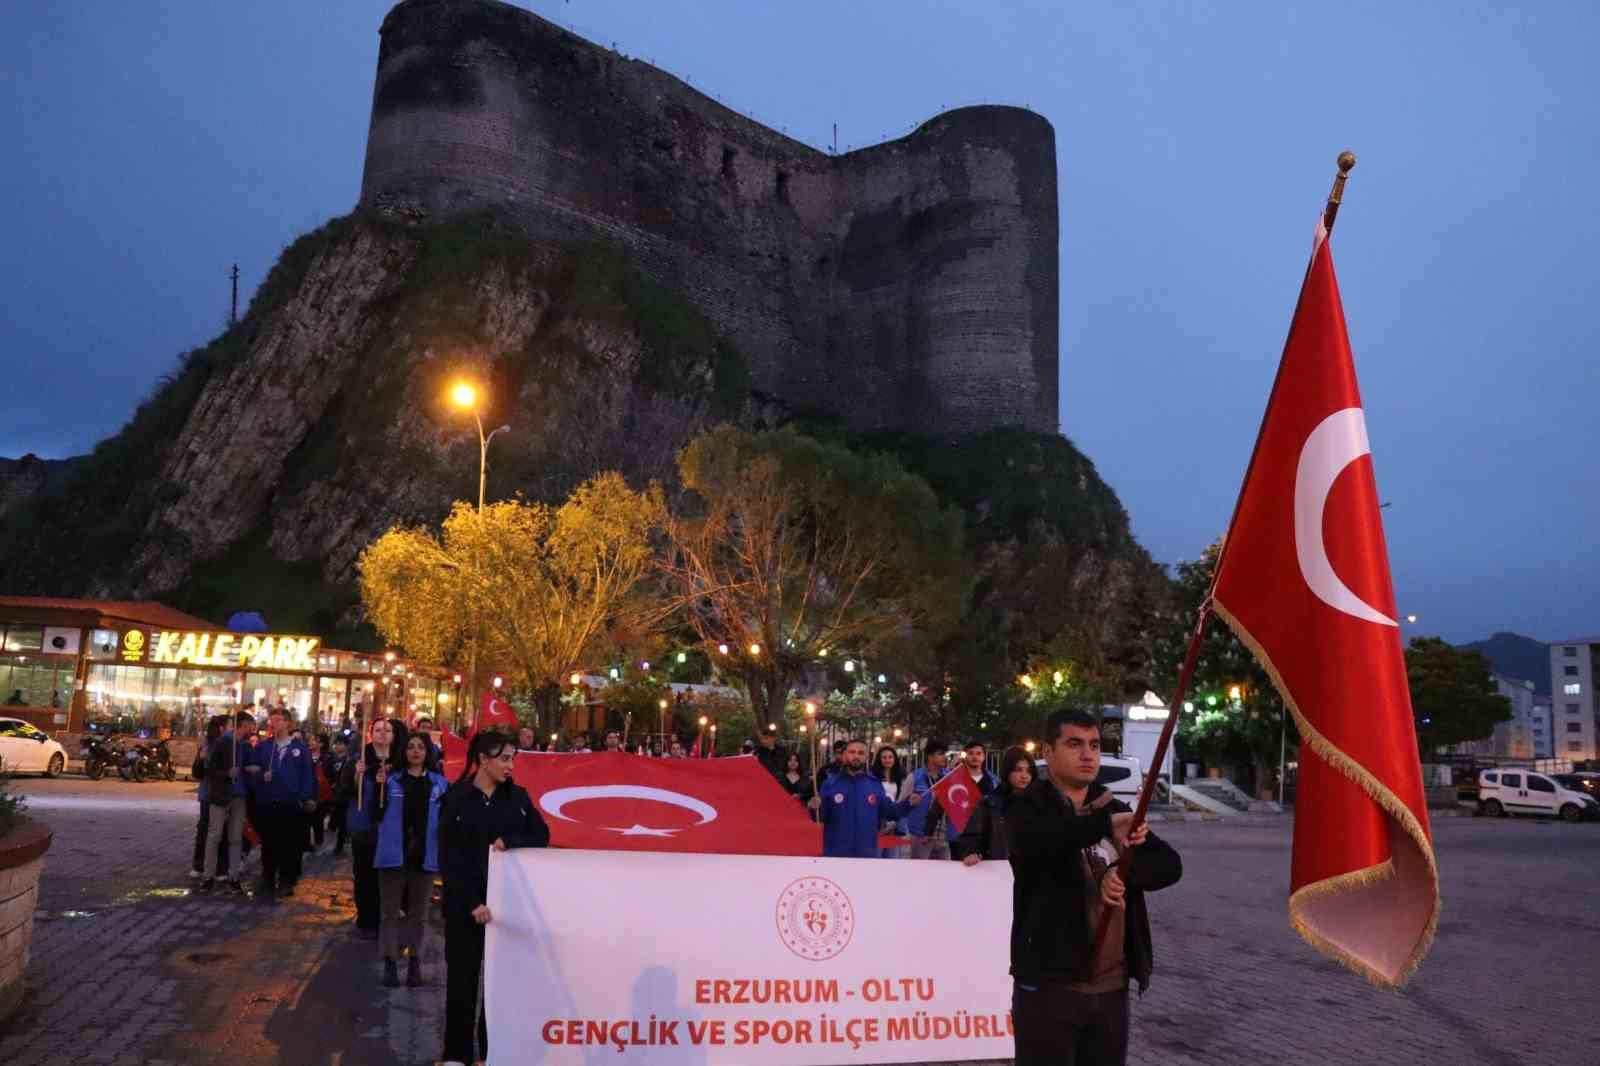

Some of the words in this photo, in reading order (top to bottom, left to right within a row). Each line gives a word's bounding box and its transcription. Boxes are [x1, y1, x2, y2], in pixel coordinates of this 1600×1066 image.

[154, 632, 234, 666] KALE
[239, 635, 317, 670] PARK
[695, 979, 839, 1004] ERZURUM
[862, 978, 935, 1003] OLTU
[541, 1014, 679, 1052] GENÇLİK
[687, 1020, 726, 1046] VE
[733, 1018, 813, 1046] SPOR
[820, 1014, 879, 1049] İLÇE
